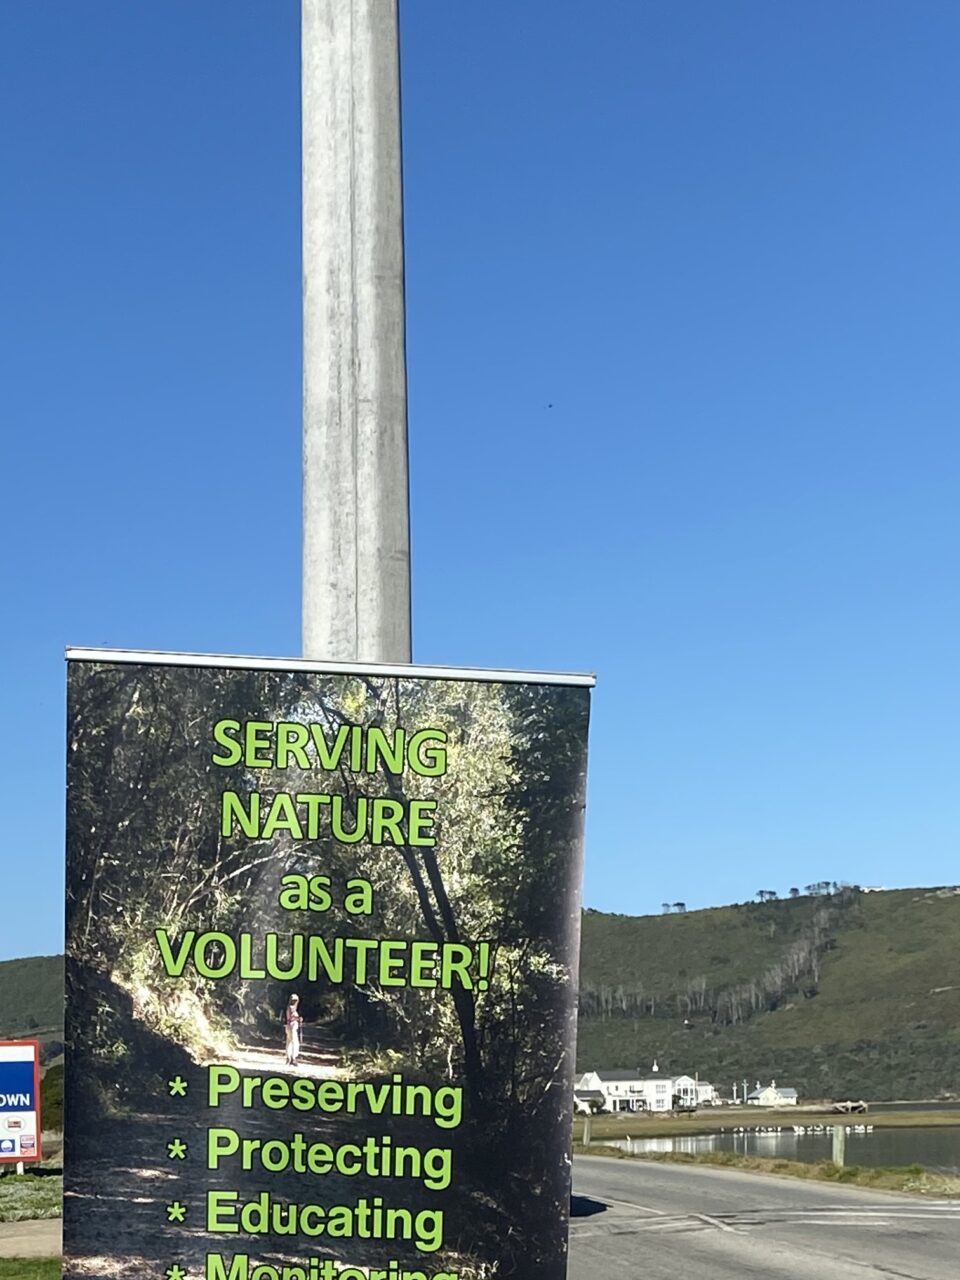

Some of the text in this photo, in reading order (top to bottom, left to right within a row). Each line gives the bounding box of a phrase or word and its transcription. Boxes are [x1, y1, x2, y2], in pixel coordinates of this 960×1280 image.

[213, 719, 447, 776] SERVING
[221, 791, 434, 845] NATURE
[280, 874, 373, 914] as a
[154, 929, 490, 989] VOLUNTEER!
[209, 1065, 463, 1127] Preserving
[207, 1128, 453, 1189] Protecting
[207, 1191, 443, 1251] Educating
